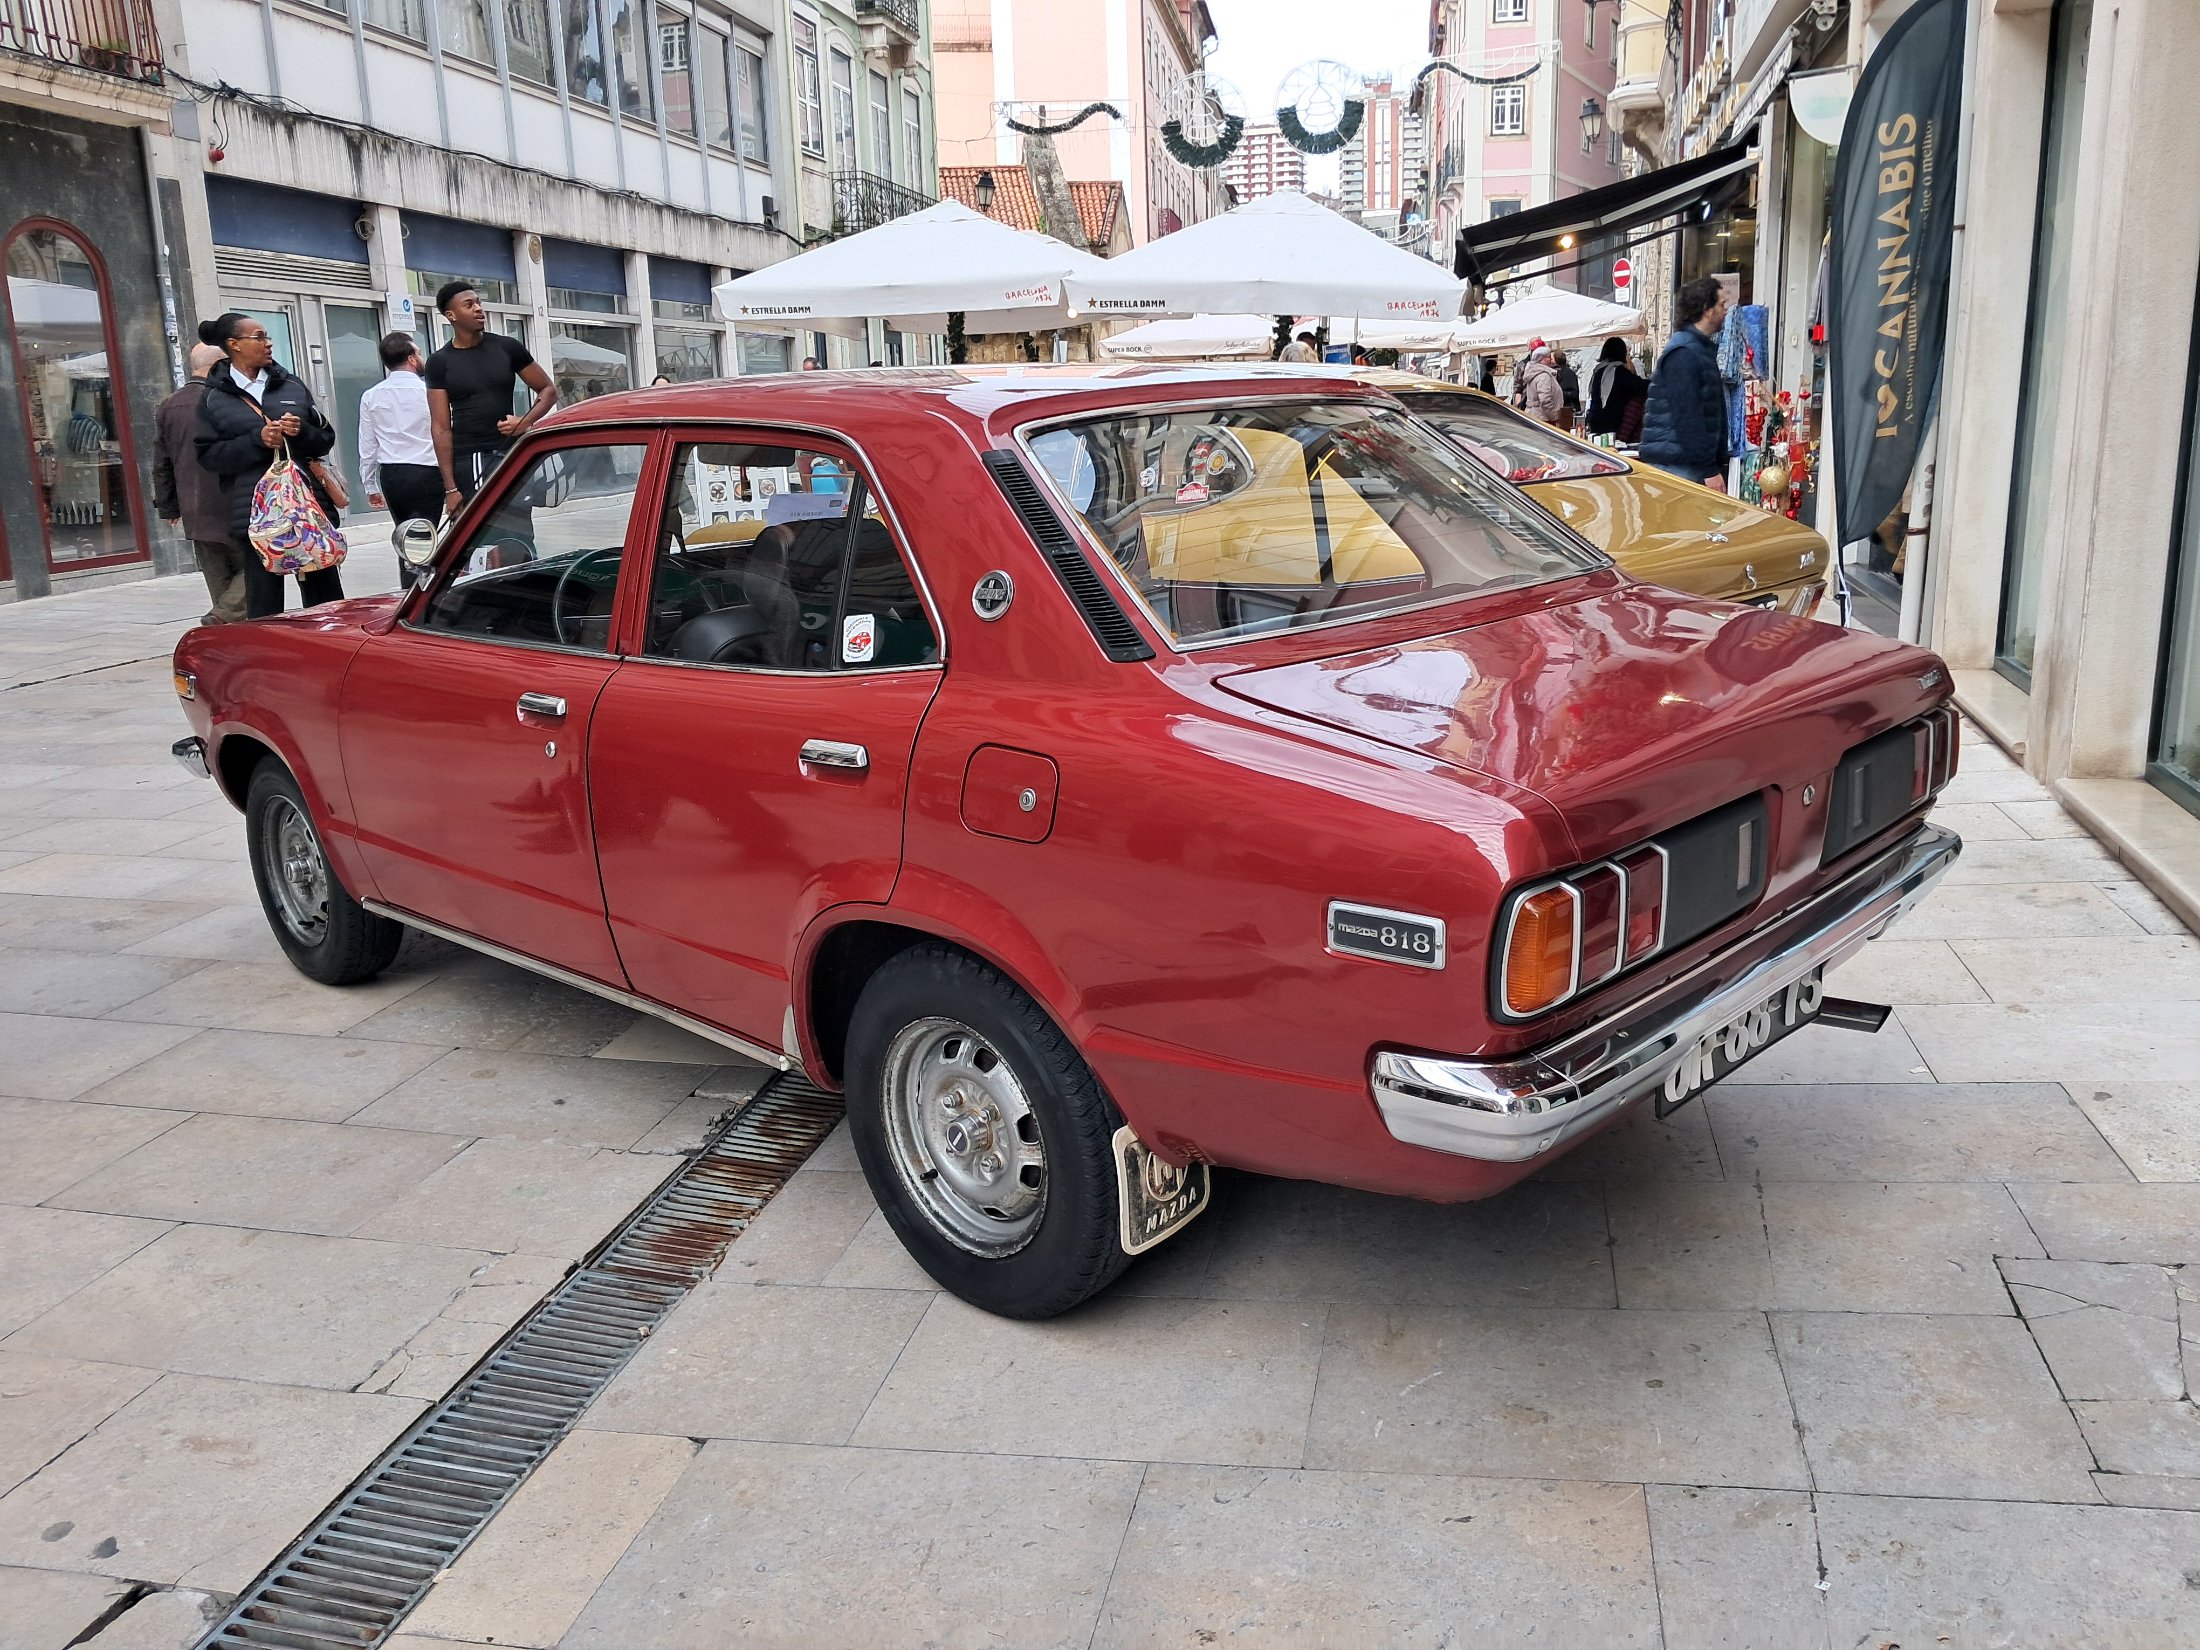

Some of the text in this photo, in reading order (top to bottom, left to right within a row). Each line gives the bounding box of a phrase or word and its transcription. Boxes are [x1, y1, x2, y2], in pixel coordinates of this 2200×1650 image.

[1874, 113, 1917, 379] CANNABIS
[1005, 285, 1048, 299] BARCELONA
[751, 306, 811, 315] ESTRELLA DAMM
[1099, 300, 1166, 308] ESTRELLA DAMM
[1387, 300, 1437, 310] BARCELONA
[1908, 301, 1918, 351] natural
[1380, 926, 1431, 954] 818
[1146, 1186, 1197, 1234] MAZDA
